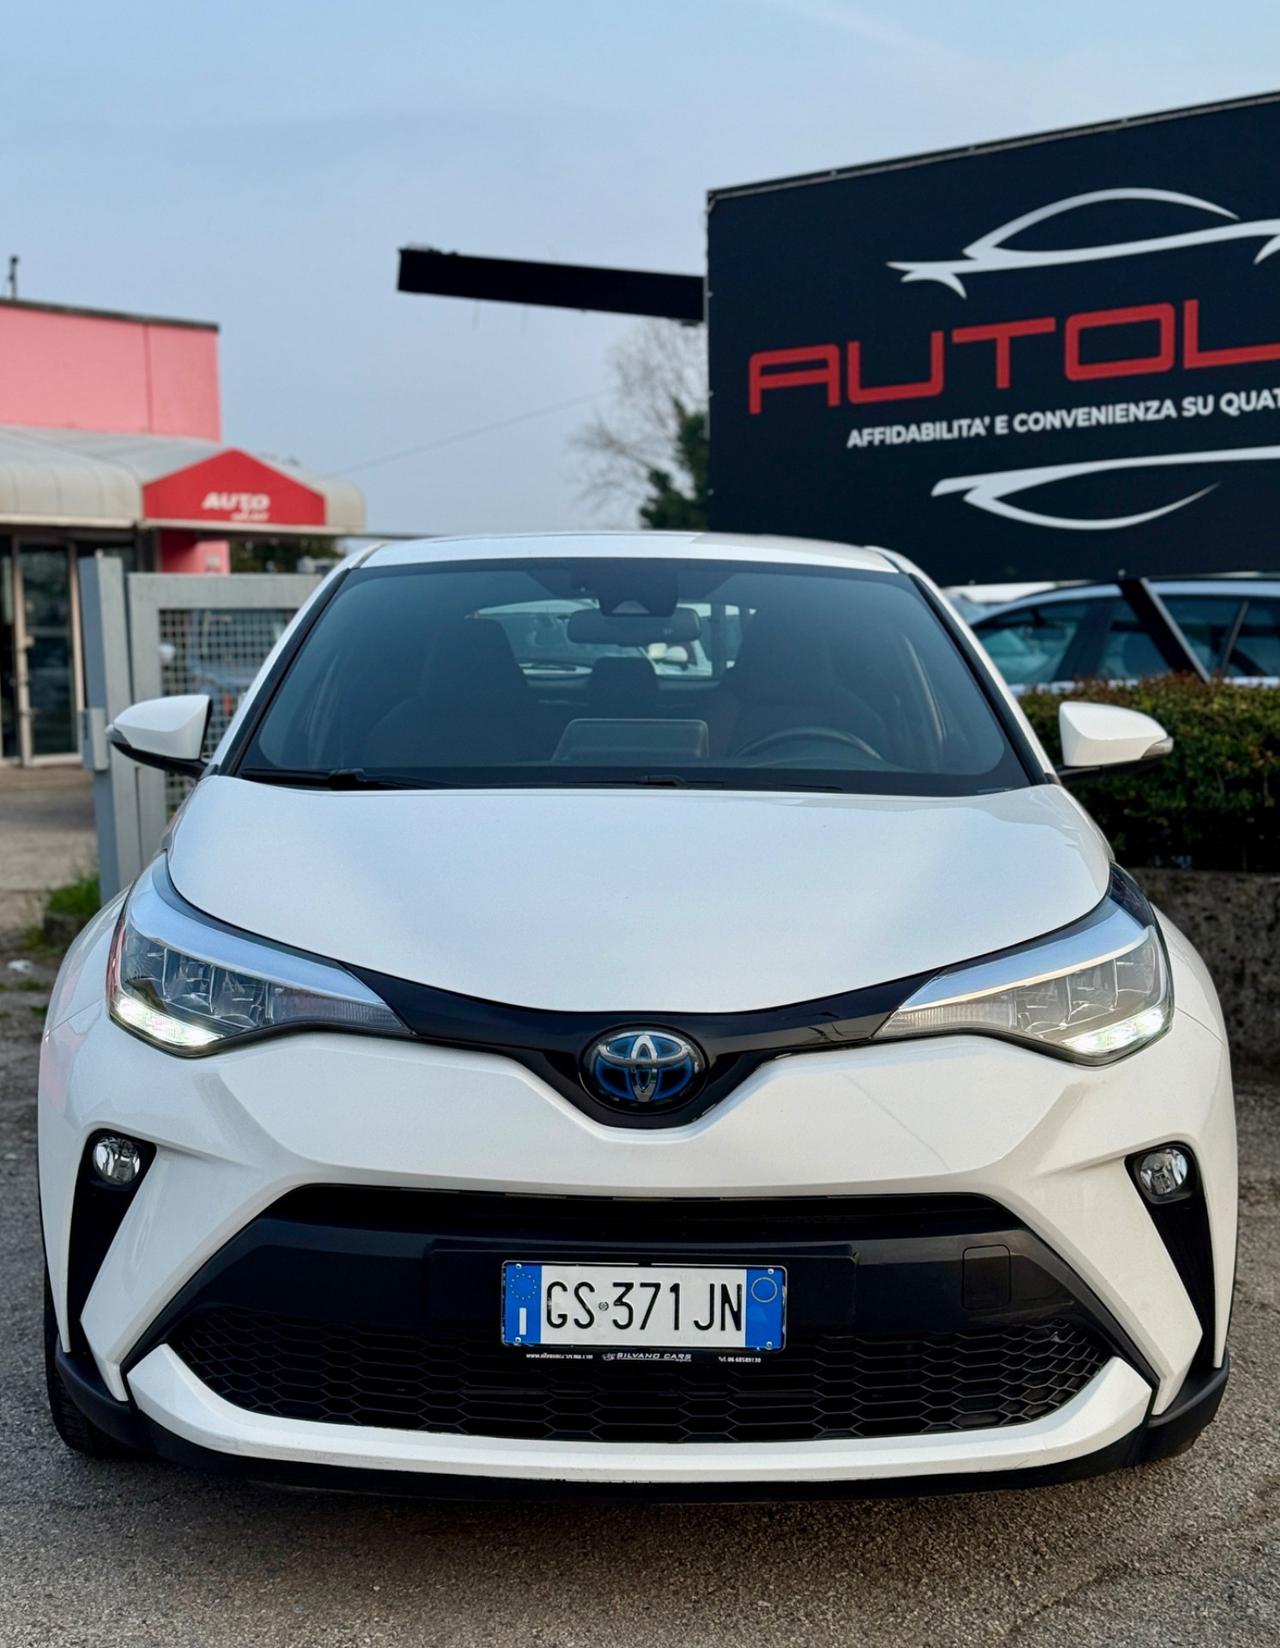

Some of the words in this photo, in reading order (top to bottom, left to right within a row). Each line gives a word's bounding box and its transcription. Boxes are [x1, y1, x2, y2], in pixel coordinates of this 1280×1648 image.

[846, 415, 991, 449] AFFIDABILITA'
[994, 414, 1010, 435] E
[1012, 398, 1178, 433] CONVENIENZA
[1181, 394, 1215, 418] SU
[201, 491, 271, 512] AUTO
[546, 1280, 596, 1329] GS
[612, 1281, 681, 1331] 371
[693, 1282, 743, 1331] JN
[616, 1352, 660, 1360] SILVANO
[663, 1353, 692, 1361] CARS
